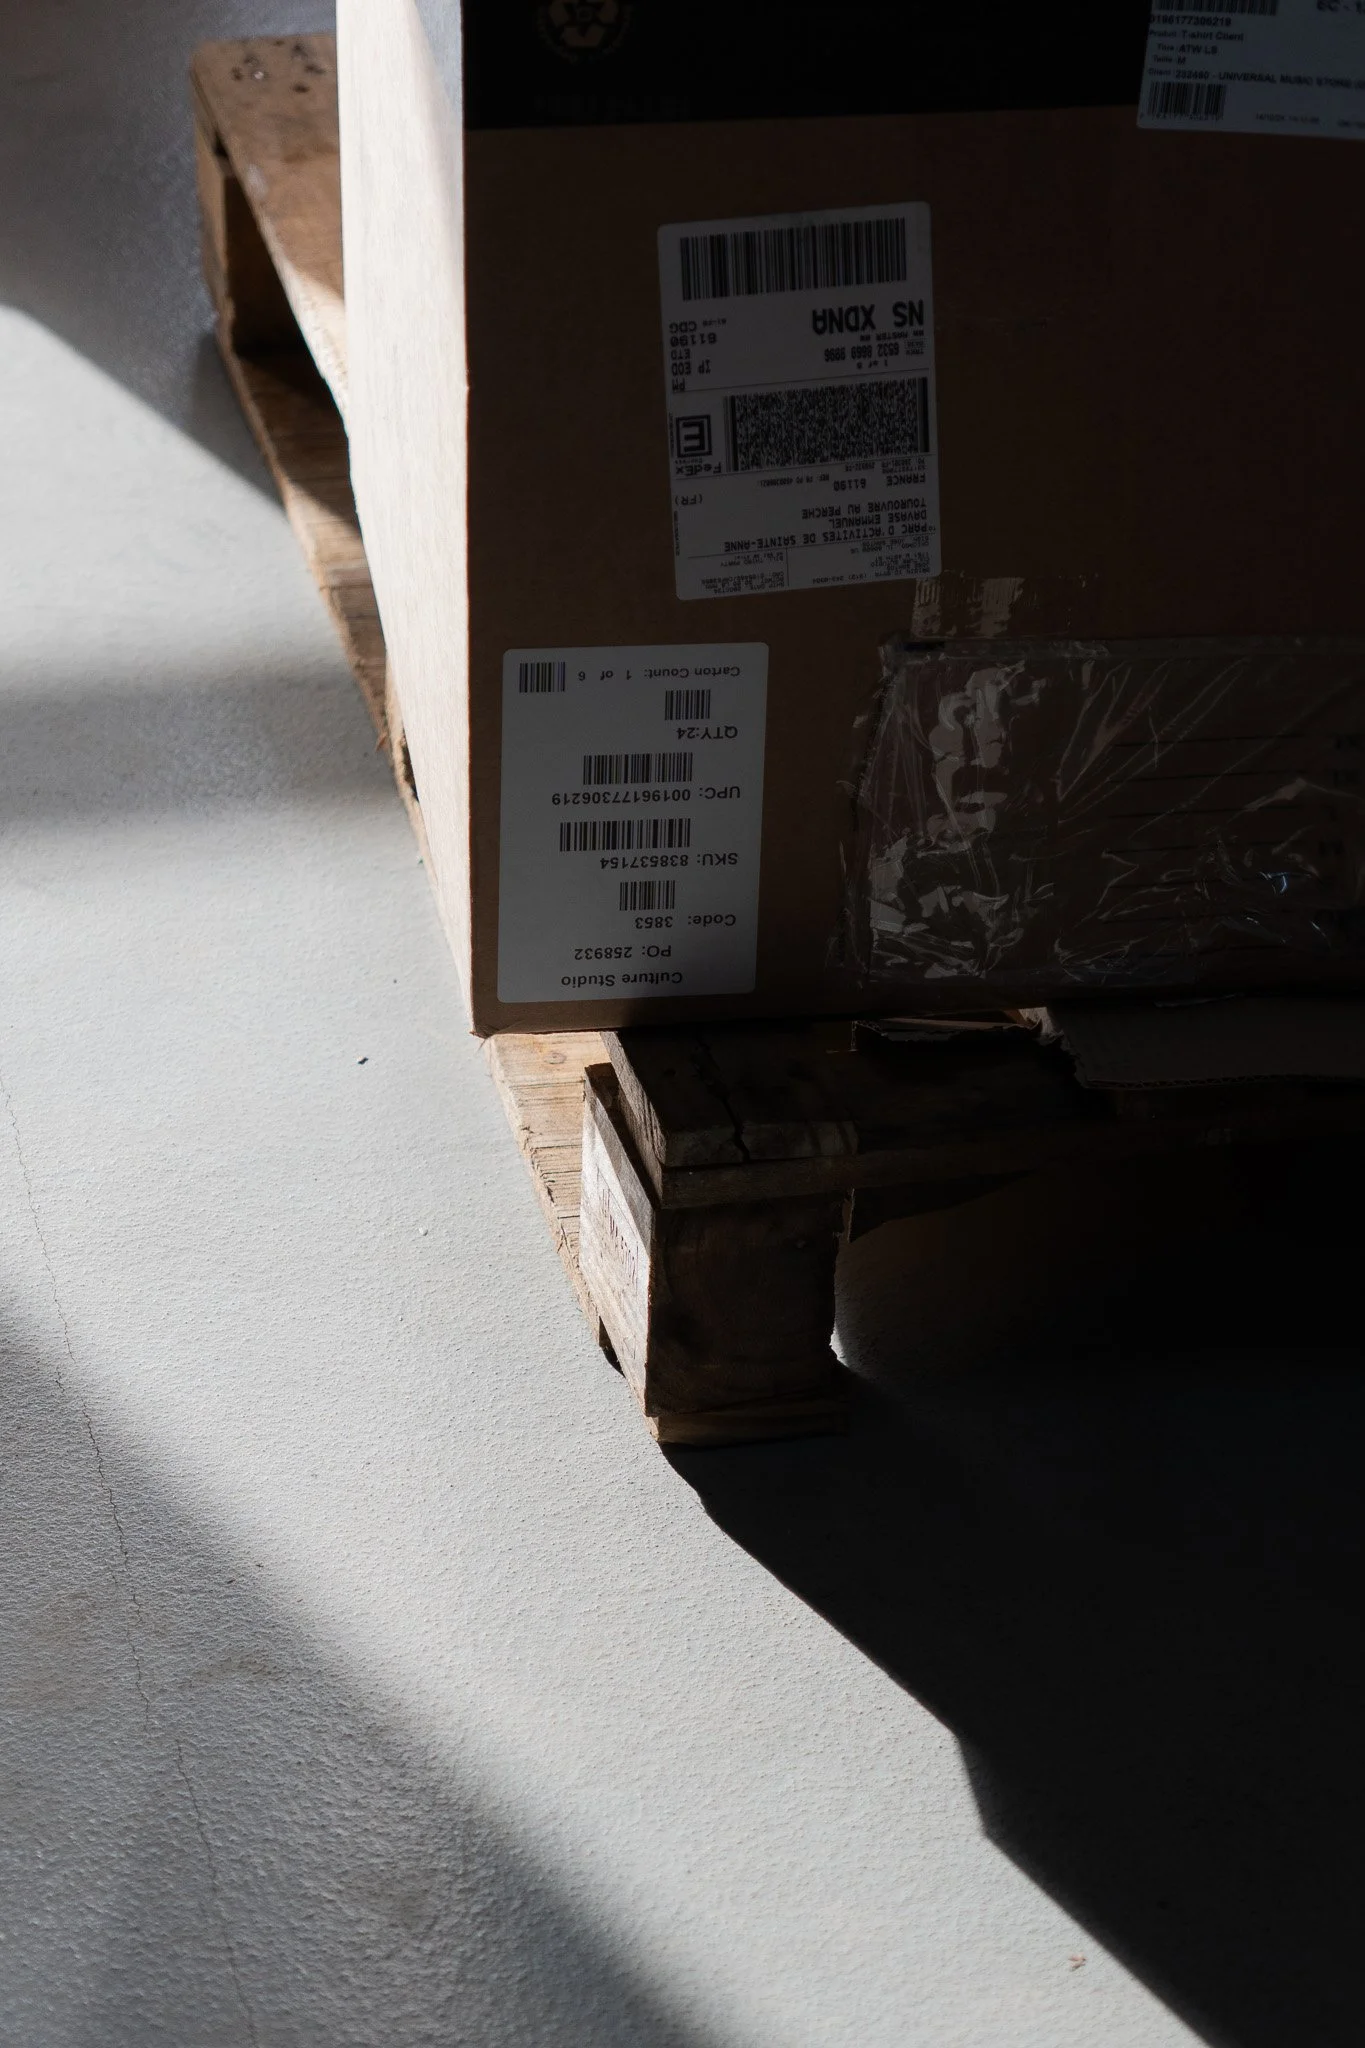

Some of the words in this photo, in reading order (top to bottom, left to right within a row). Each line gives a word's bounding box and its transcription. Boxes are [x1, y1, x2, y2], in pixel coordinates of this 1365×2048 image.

[1219, 72, 1277, 84] UNIVERSAL
[812, 304, 876, 336] XDNA
[892, 299, 924, 328] NS
[669, 321, 697, 334] CDG
[670, 348, 691, 360] ETD
[671, 361, 691, 375] EOD
[698, 359, 711, 374] IP
[671, 377, 685, 392] PM
[682, 421, 705, 452] E
[675, 462, 722, 476] FedEx
[833, 478, 867, 491] 61190
[886, 474, 926, 486] FRANCE
[674, 494, 703, 506] (FR)
[868, 497, 926, 514] TOUROUVRE
[801, 505, 841, 519] PERCHE
[847, 503, 861, 516] AU
[887, 509, 927, 523] DAVASE
[828, 514, 881, 529] EMMANUEL
[901, 522, 927, 534] PARC
[724, 534, 796, 552] SAINTE-ANNE
[803, 533, 816, 544] DE
[577, 670, 586, 681] 6
[599, 670, 614, 682] of
[625, 670, 632, 681] 1
[644, 667, 690, 680] Count:
[694, 666, 741, 678] Carton
[676, 725, 738, 740] QTY:24
[551, 788, 692, 806] 00196177306219
[698, 786, 741, 800] UPC:
[599, 854, 689, 870] 838537154
[696, 852, 738, 866] SKU:
[634, 916, 674, 929] 3853
[687, 913, 737, 927] Code:
[574, 946, 633, 961] 258932
[641, 945, 672, 958] PO:
[560, 973, 616, 989] Studio
[621, 971, 683, 987] Culture
